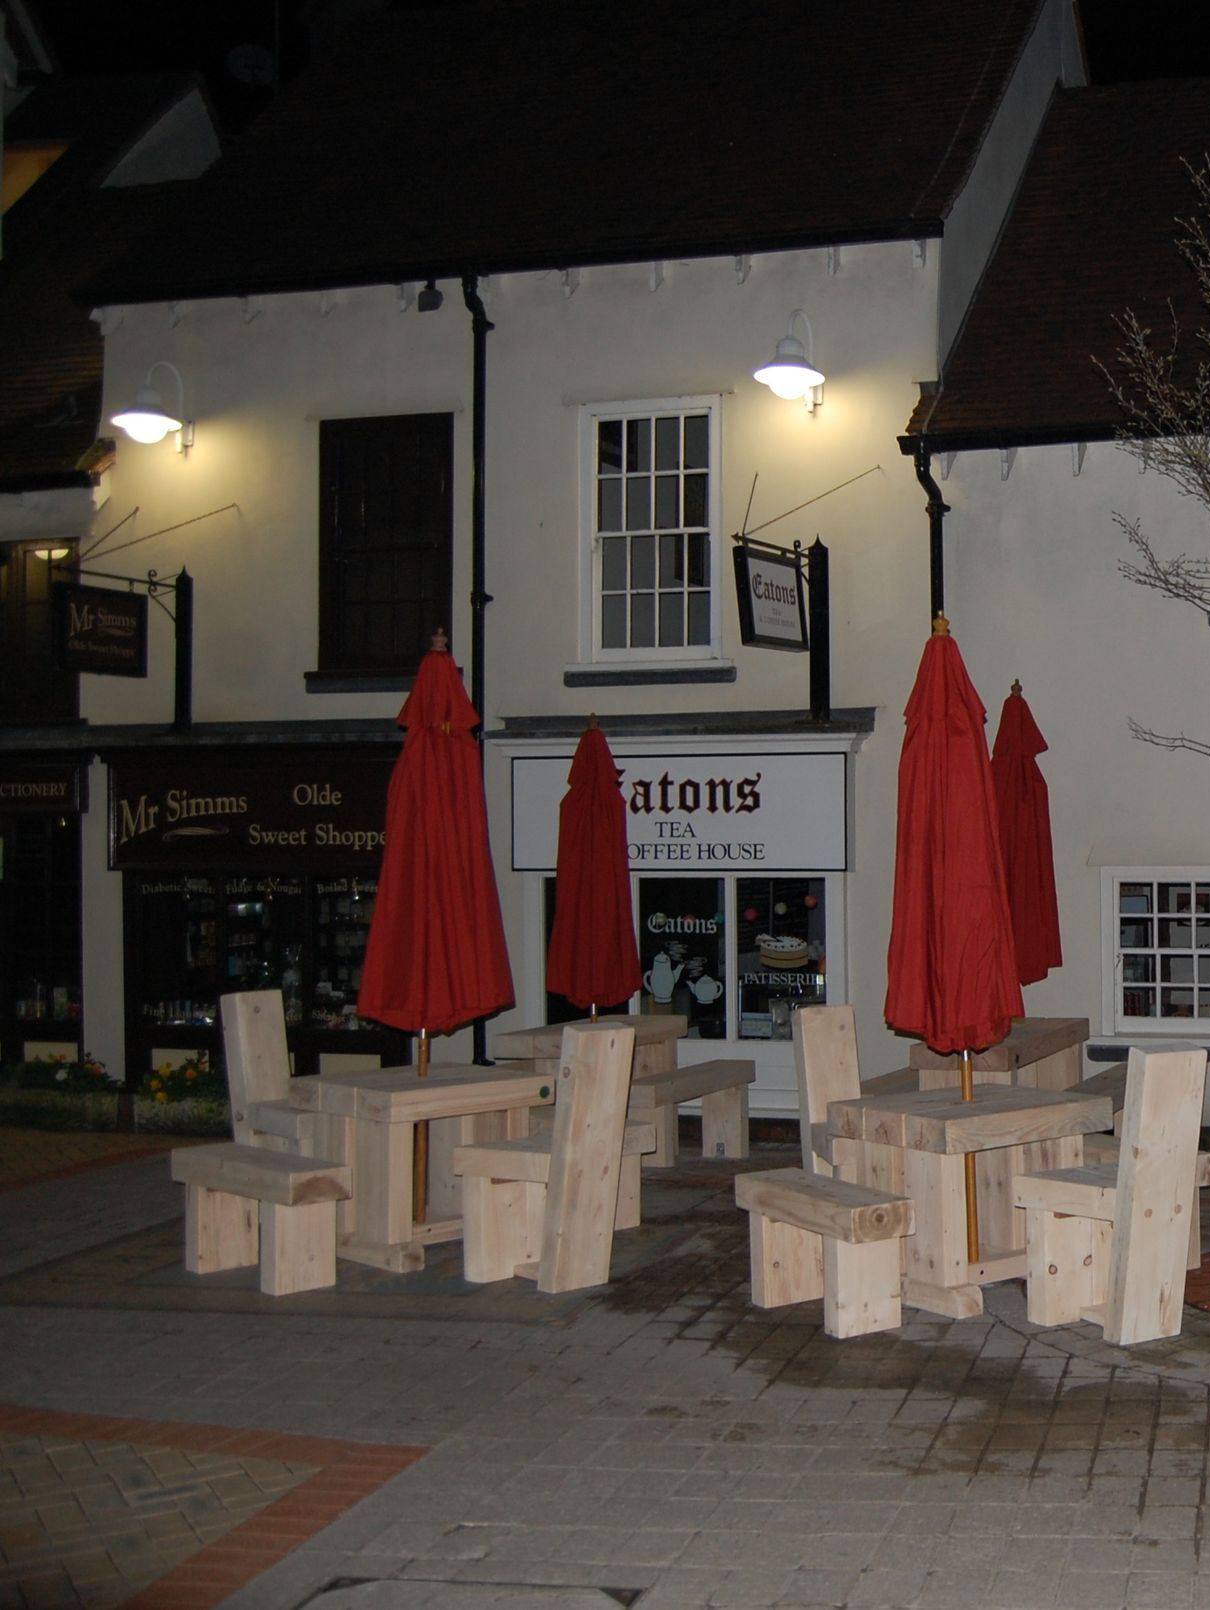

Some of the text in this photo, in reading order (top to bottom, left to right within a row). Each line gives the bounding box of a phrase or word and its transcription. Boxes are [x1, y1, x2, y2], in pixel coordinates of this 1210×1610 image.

[752, 572, 797, 606] Eatons
[69, 602, 136, 637] Mr Simms
[292, 783, 343, 806] Olde
[615, 769, 763, 815] atons
[119, 788, 248, 844] Mr Simms
[248, 825, 387, 851] Sweet Shoppe
[655, 822, 697, 839] TEA
[628, 843, 766, 861] OFFEE HOUSE
[648, 912, 719, 935] Eatons
[744, 973, 825, 986] PATISSERIE
